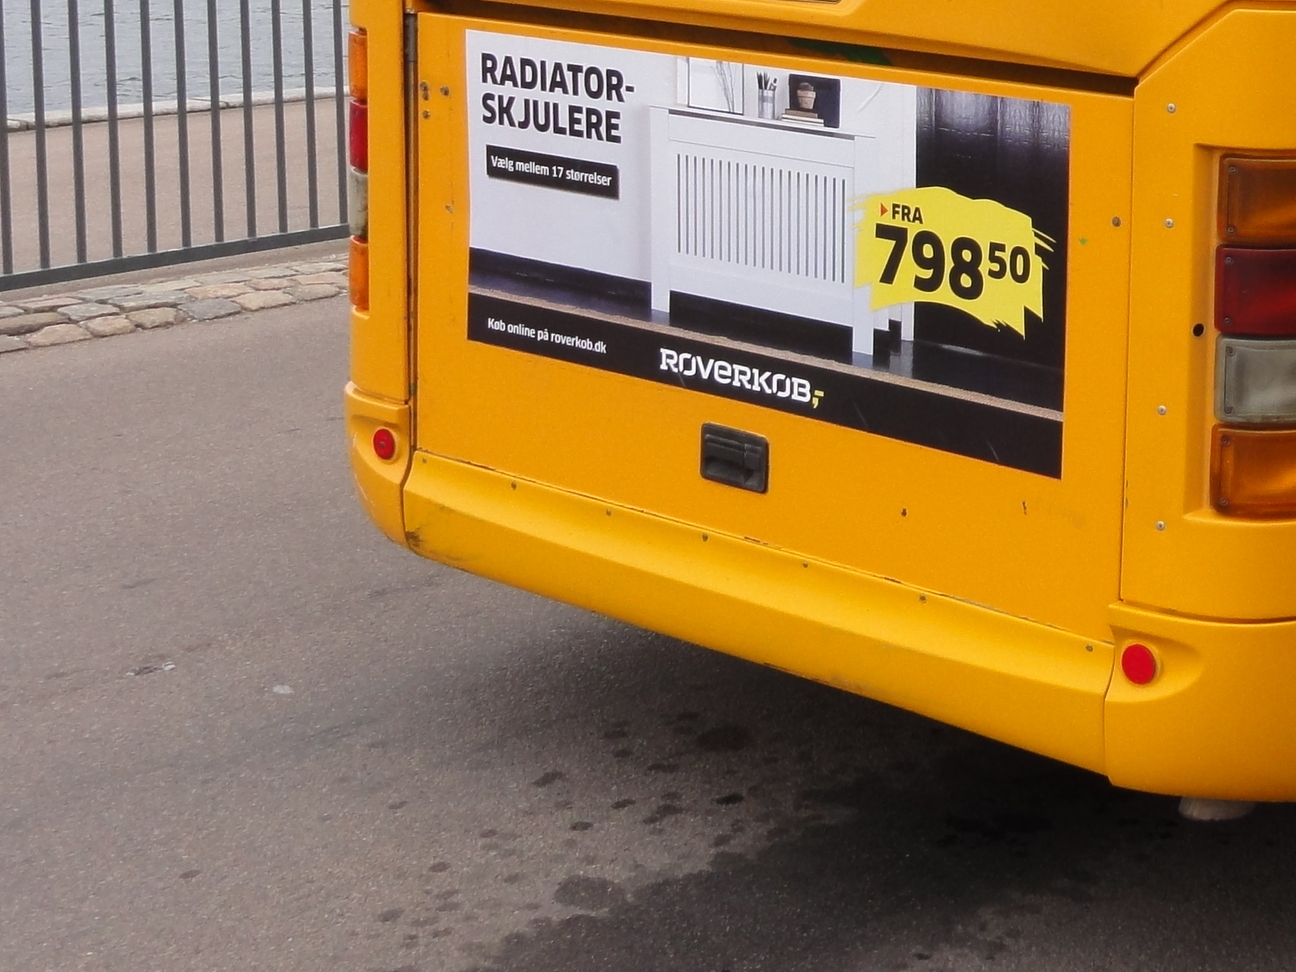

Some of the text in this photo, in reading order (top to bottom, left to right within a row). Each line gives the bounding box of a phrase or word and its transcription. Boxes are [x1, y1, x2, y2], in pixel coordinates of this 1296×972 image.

[481, 51, 635, 103] RADIATOR-
[481, 92, 622, 144] SKJULERE
[490, 155, 613, 186] Vælg mellem 17 størrelser
[891, 203, 924, 225] FRA
[487, 317, 607, 354] Køb online på roverkob.dk
